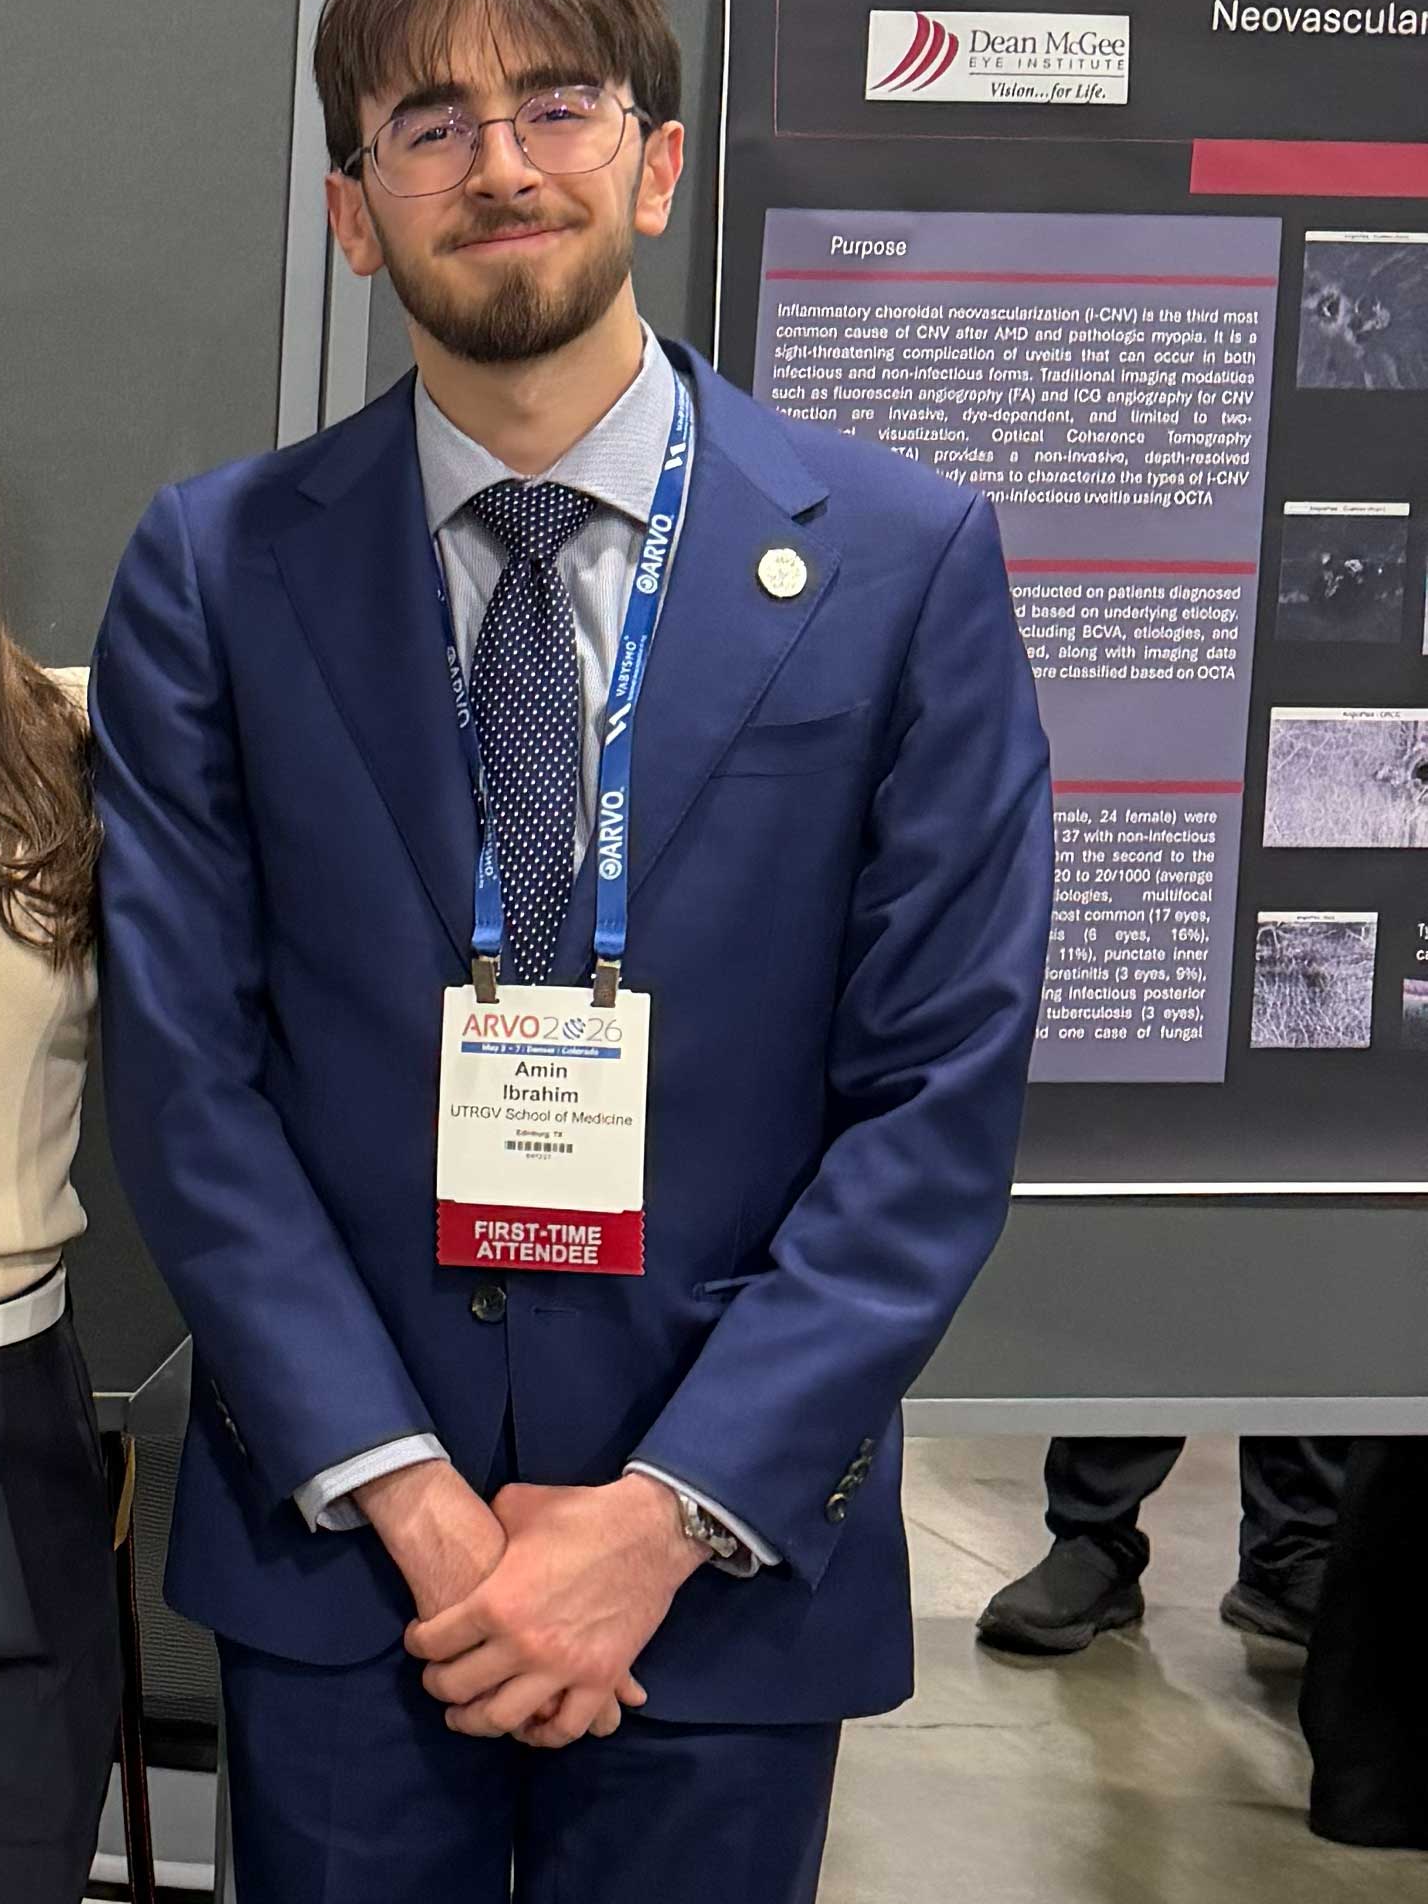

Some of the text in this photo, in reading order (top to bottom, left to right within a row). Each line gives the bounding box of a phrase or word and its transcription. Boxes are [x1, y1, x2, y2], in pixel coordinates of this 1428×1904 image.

[970, 30, 1126, 59] Dean McGee
[970, 58, 1126, 72] EYE INSTITUTE
[1077, 81, 1106, 100] Life.
[830, 236, 906, 259] Purpose
[462, 1013, 540, 1039] ARVO
[515, 1061, 568, 1079] Amin
[503, 1084, 579, 1104] Ibrahim
[451, 1105, 633, 1126] UTRGV School of Medicine
[474, 1220, 602, 1245] FIRST-TIME
[477, 1242, 599, 1265] ATTENDEE
